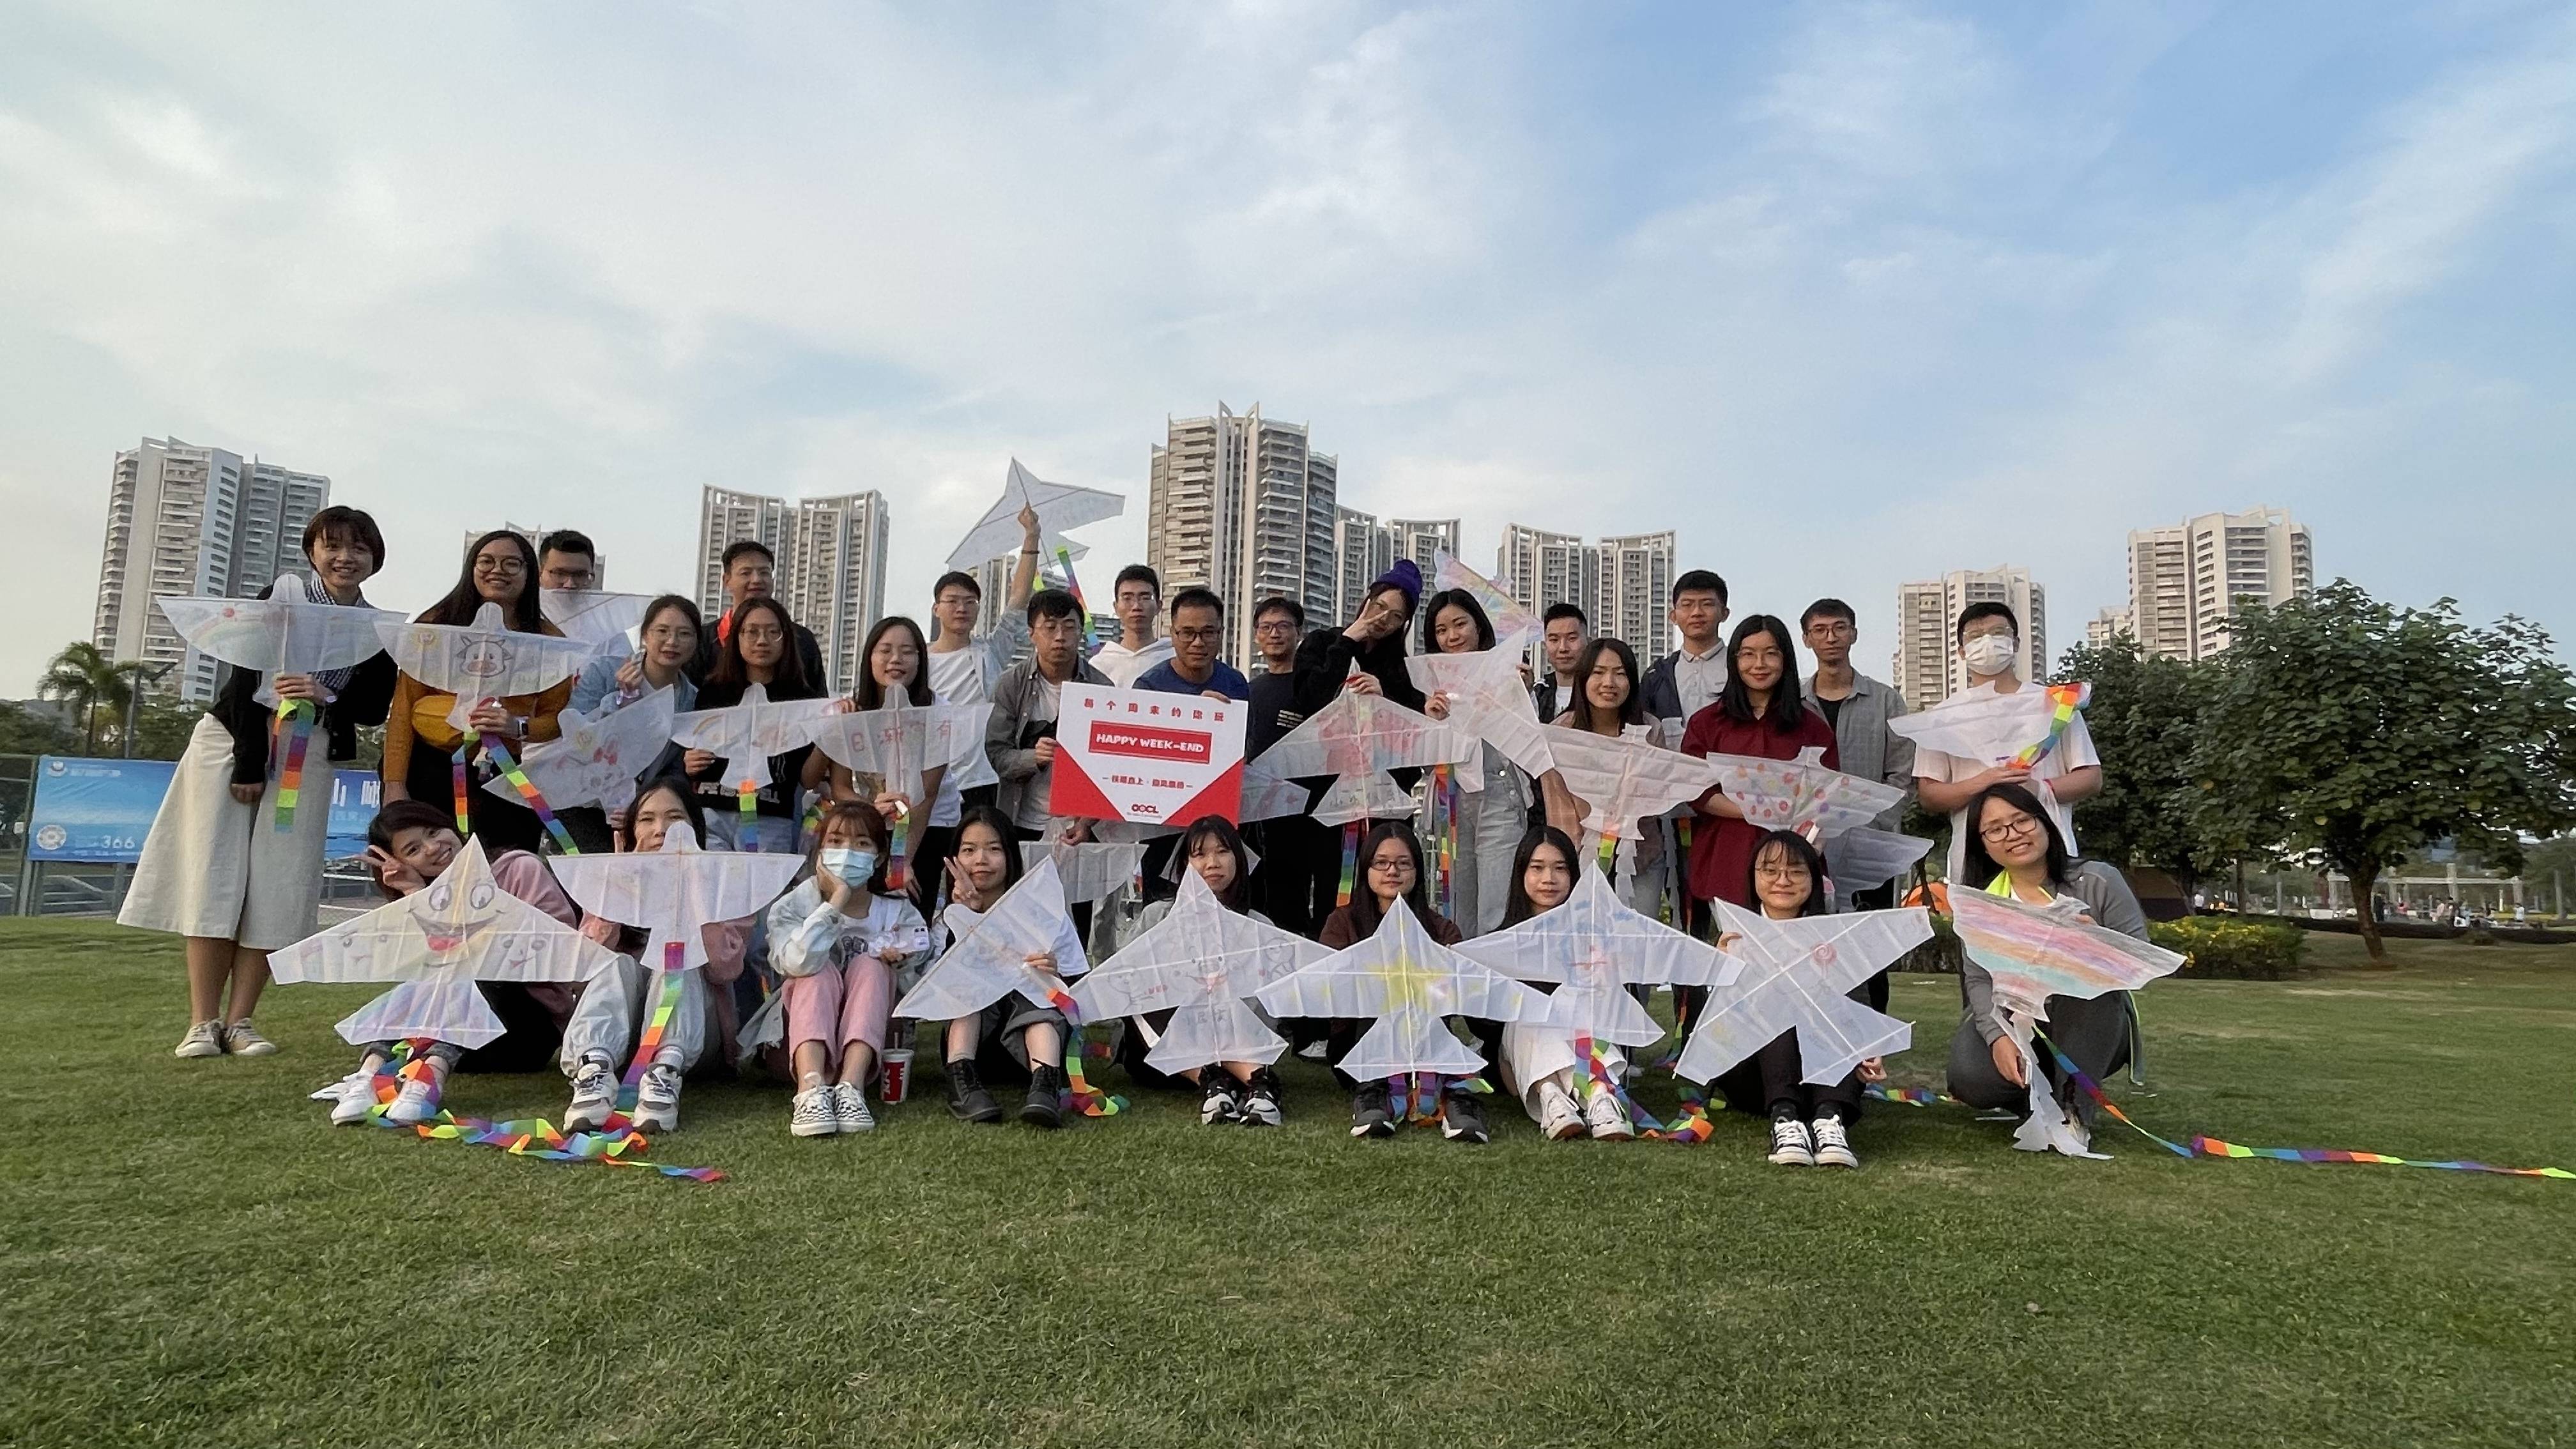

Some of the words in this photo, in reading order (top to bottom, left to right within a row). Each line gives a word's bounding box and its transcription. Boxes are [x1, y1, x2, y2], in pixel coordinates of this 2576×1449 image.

[1096, 733, 1138, 746] HAPPY
[1140, 739, 1204, 753] WEEK-END
[102, 834, 135, 848] 366
